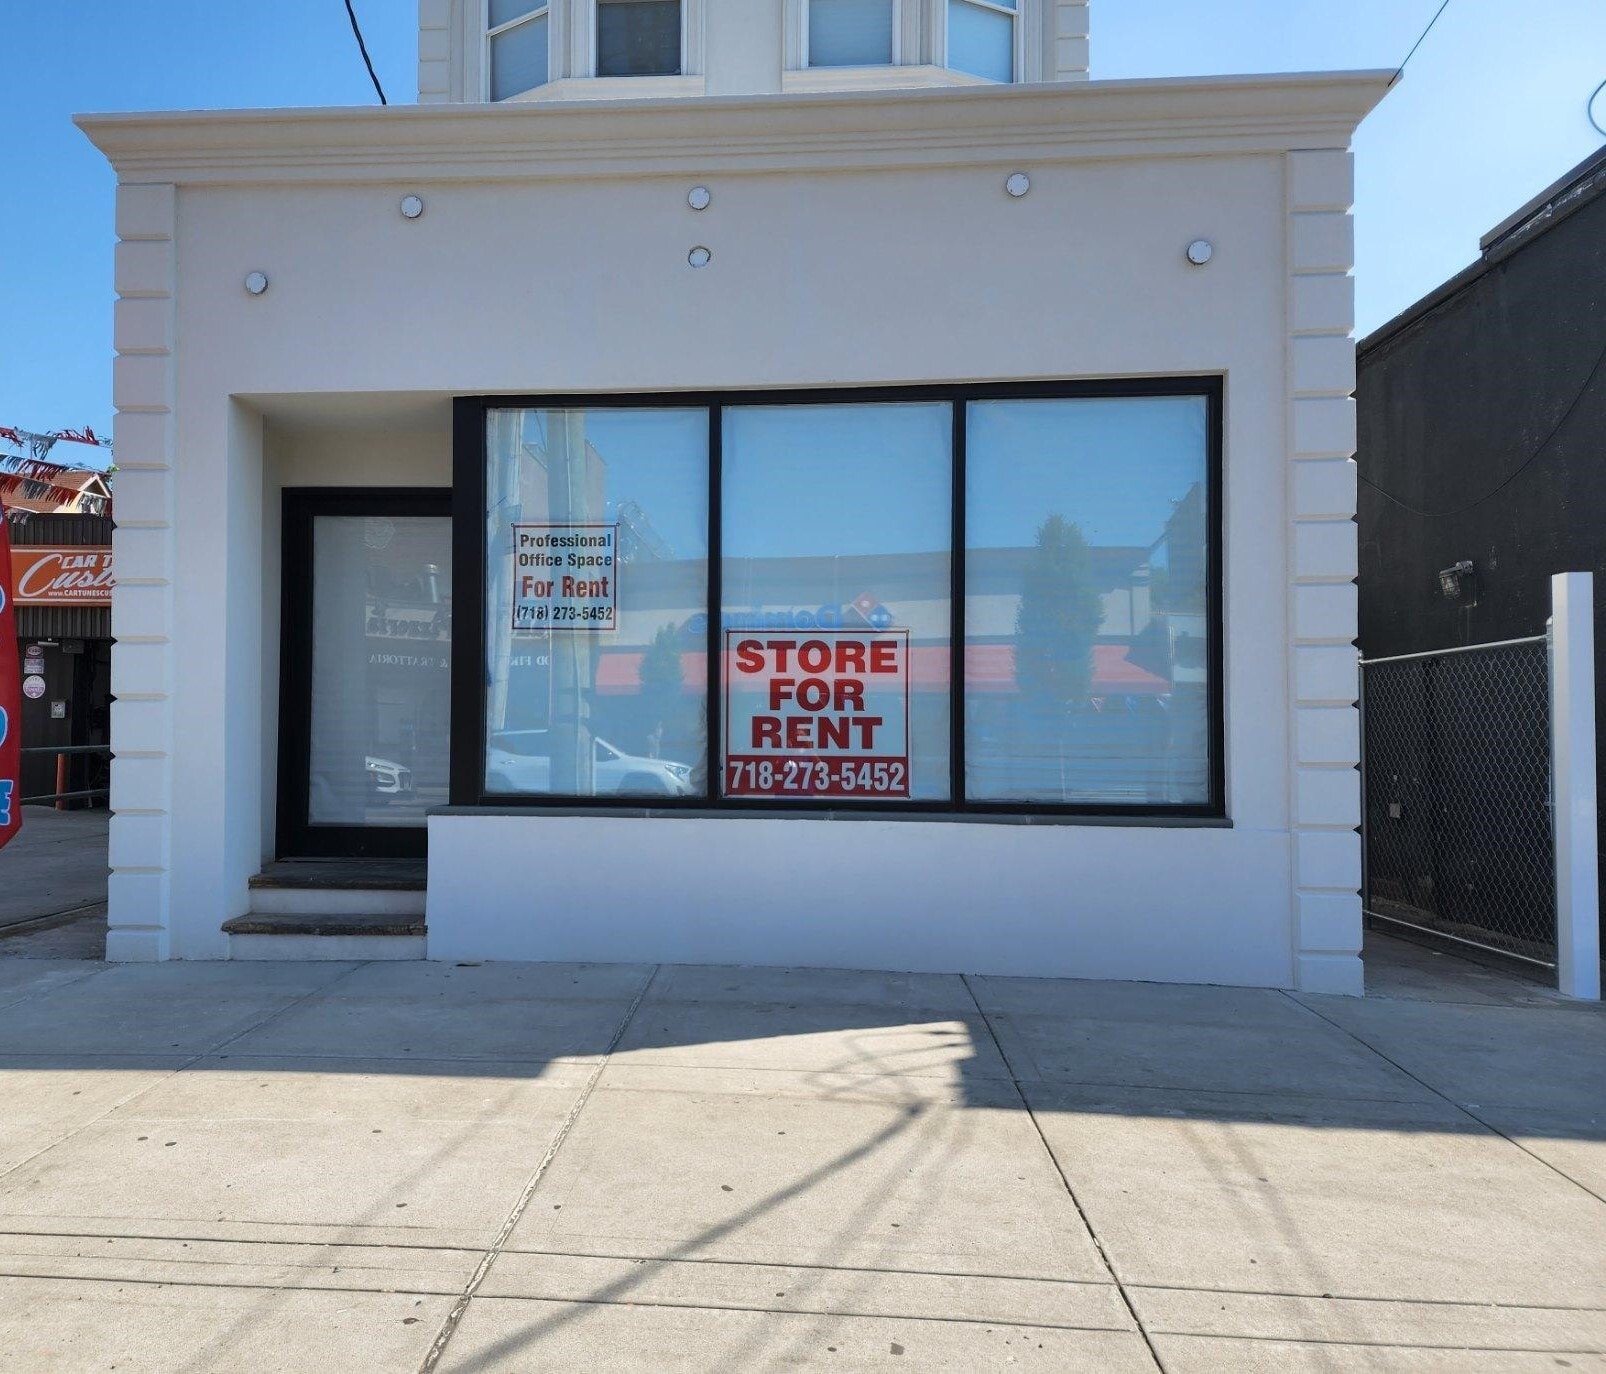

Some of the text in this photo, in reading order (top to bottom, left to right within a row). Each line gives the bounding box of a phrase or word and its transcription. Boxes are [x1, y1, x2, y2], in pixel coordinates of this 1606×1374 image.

[520, 533, 612, 547] Professional
[61, 554, 98, 569] CAR
[519, 553, 612, 569] Office Space
[522, 575, 609, 598] For Rent
[516, 605, 613, 621] (718) 273-5452
[736, 639, 898, 674] STORE
[769, 678, 865, 712] FOR
[751, 716, 883, 749] RENT
[729, 760, 905, 791] 718-273-5452
